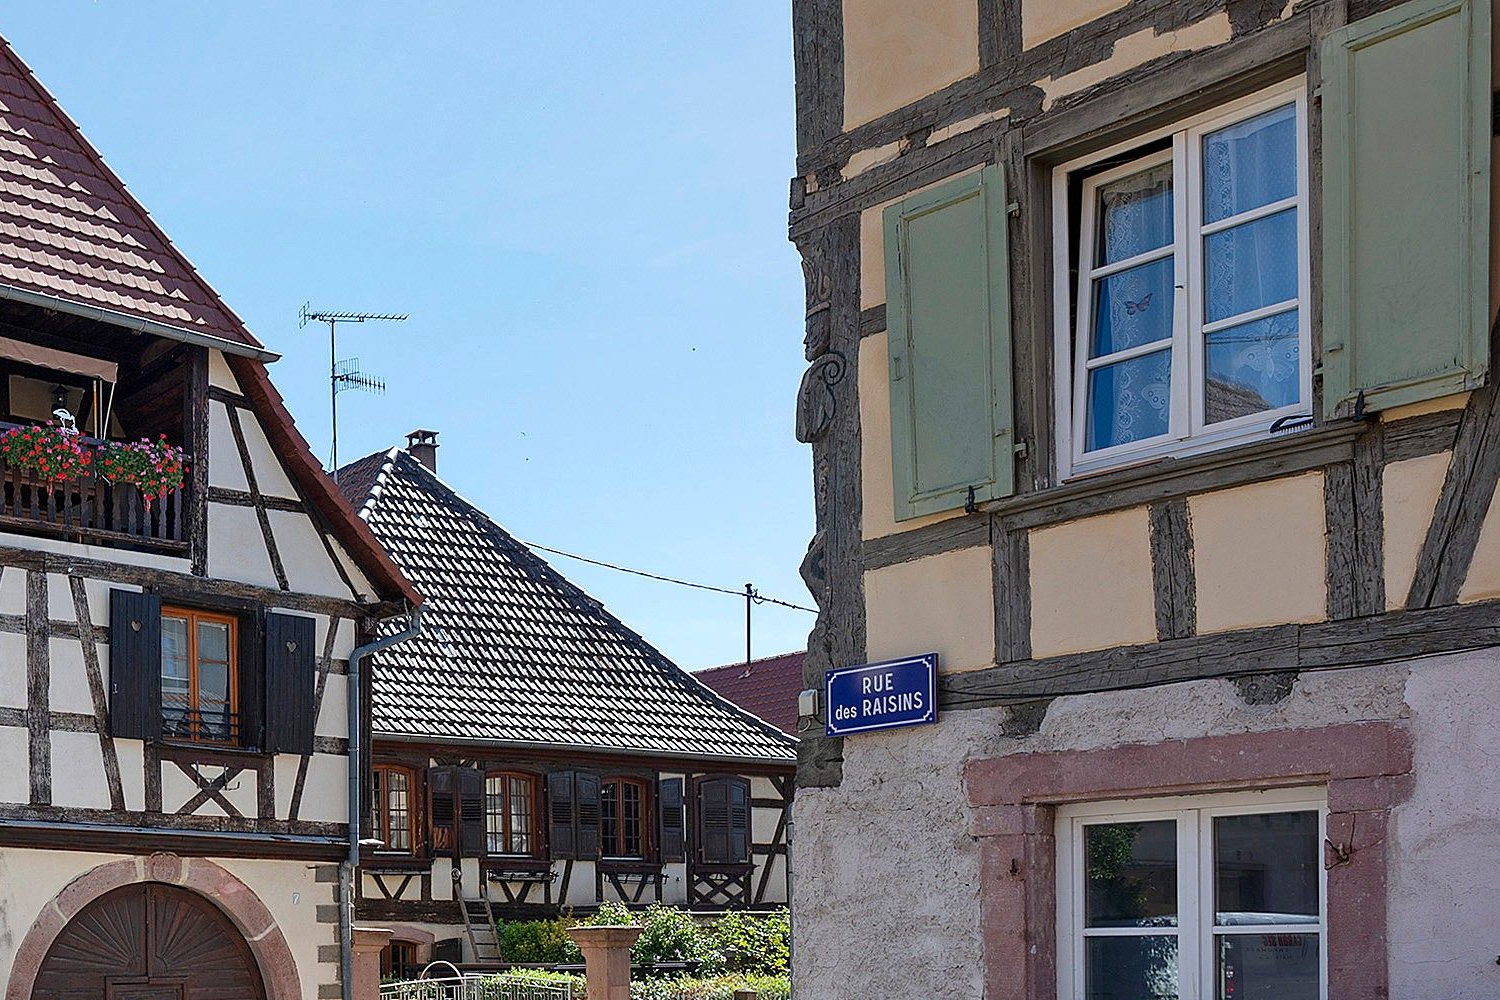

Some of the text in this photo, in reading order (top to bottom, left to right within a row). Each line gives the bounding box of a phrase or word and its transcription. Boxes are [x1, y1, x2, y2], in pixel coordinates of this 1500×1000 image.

[863, 673, 893, 694] RUE
[835, 691, 923, 720] des RAISINS
